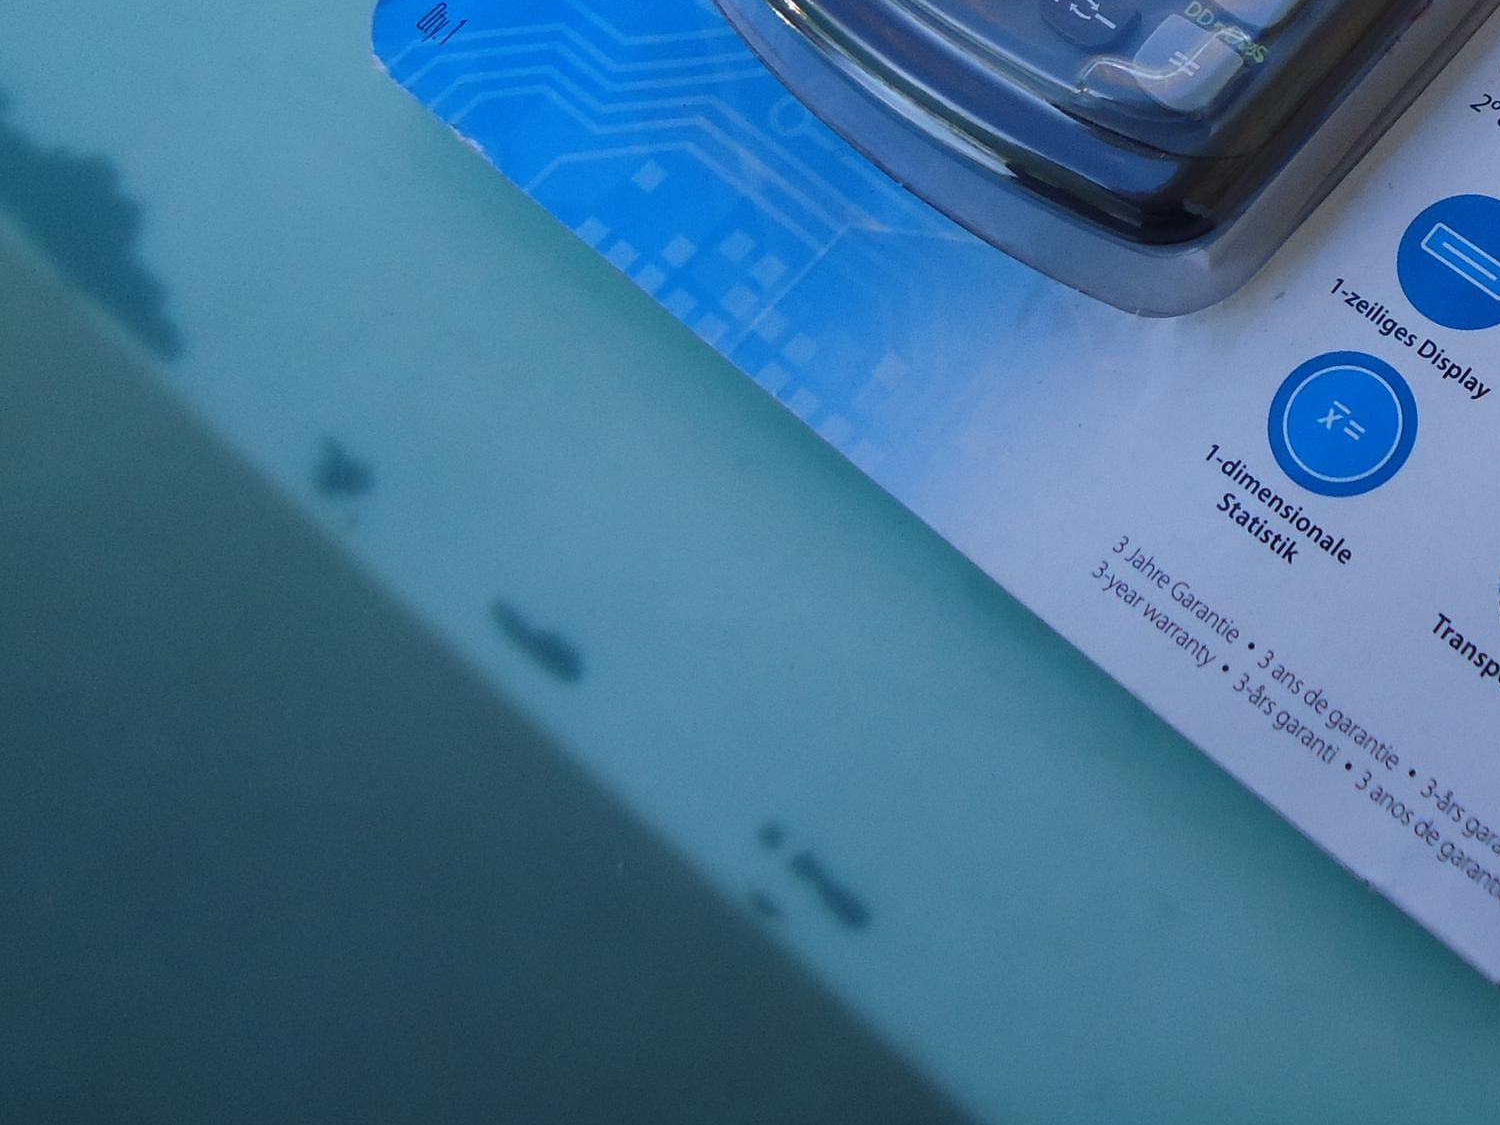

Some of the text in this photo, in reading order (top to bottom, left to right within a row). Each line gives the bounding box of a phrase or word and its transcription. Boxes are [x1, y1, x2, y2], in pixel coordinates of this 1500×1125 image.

[1330, 278, 1491, 401] 1-zeiliges Display
[1205, 443, 1353, 565] 1-dimensionale
[1217, 493, 1300, 565] Statistik
[1090, 560, 1145, 608] 3-year
[1143, 601, 1217, 668] warranty
[1232, 673, 1278, 716] 3-års
[1273, 708, 1341, 765] garanti
[1355, 772, 1373, 792] 3
[1368, 784, 1416, 828] anos
[1413, 815, 1442, 846] de
[1112, 536, 1130, 554] 3
[1124, 545, 1171, 590] Jahre
[1171, 581, 1241, 644] Garantie
[1257, 650, 1276, 669] 3
[1271, 665, 1305, 695] ans
[1303, 687, 1330, 715] de
[1327, 707, 1401, 772] garantie
[1419, 778, 1466, 822] 3-års
